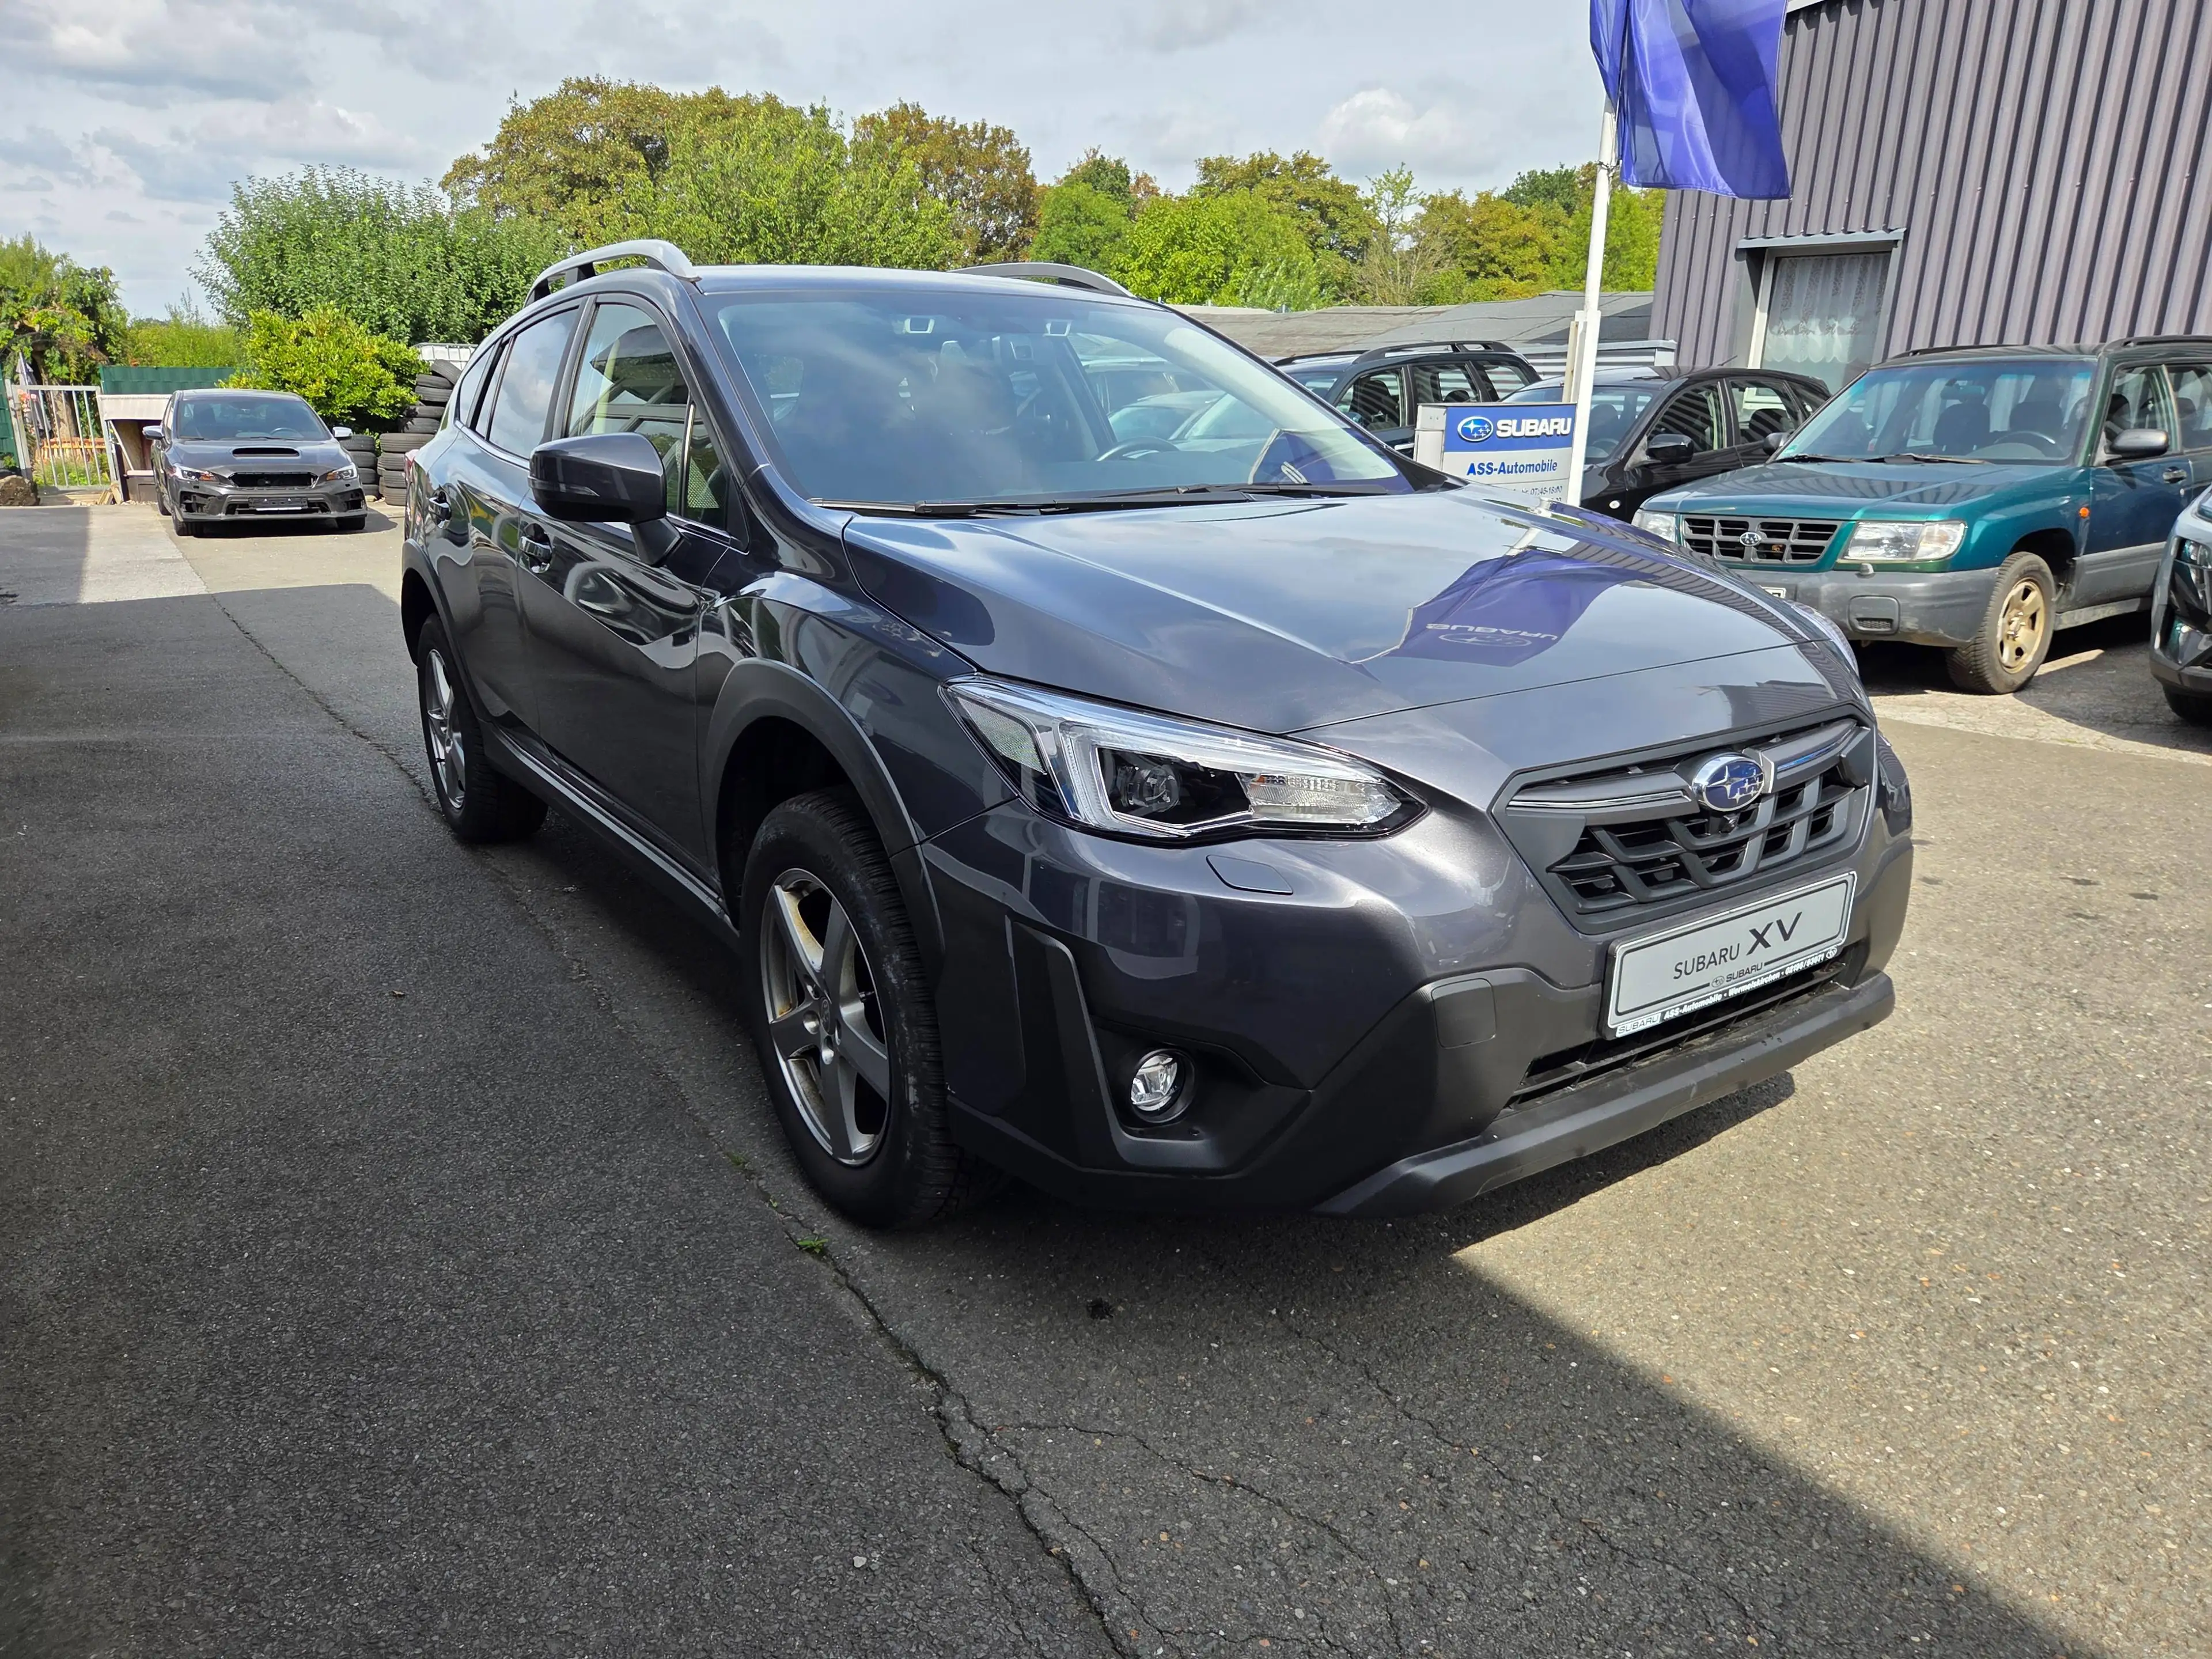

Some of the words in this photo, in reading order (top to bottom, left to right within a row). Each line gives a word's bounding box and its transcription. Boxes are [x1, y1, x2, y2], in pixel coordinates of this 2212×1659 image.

[1496, 418, 1572, 438] SUBARU
[1467, 460, 1558, 476] ASS-Automobile
[1673, 943, 1740, 980] SUBARU
[1746, 912, 1802, 956] XV
[1726, 963, 1763, 982] SUBARU
[1618, 1015, 1659, 1035] SUBARU
[1663, 993, 1722, 1020] ASS-Automobile
